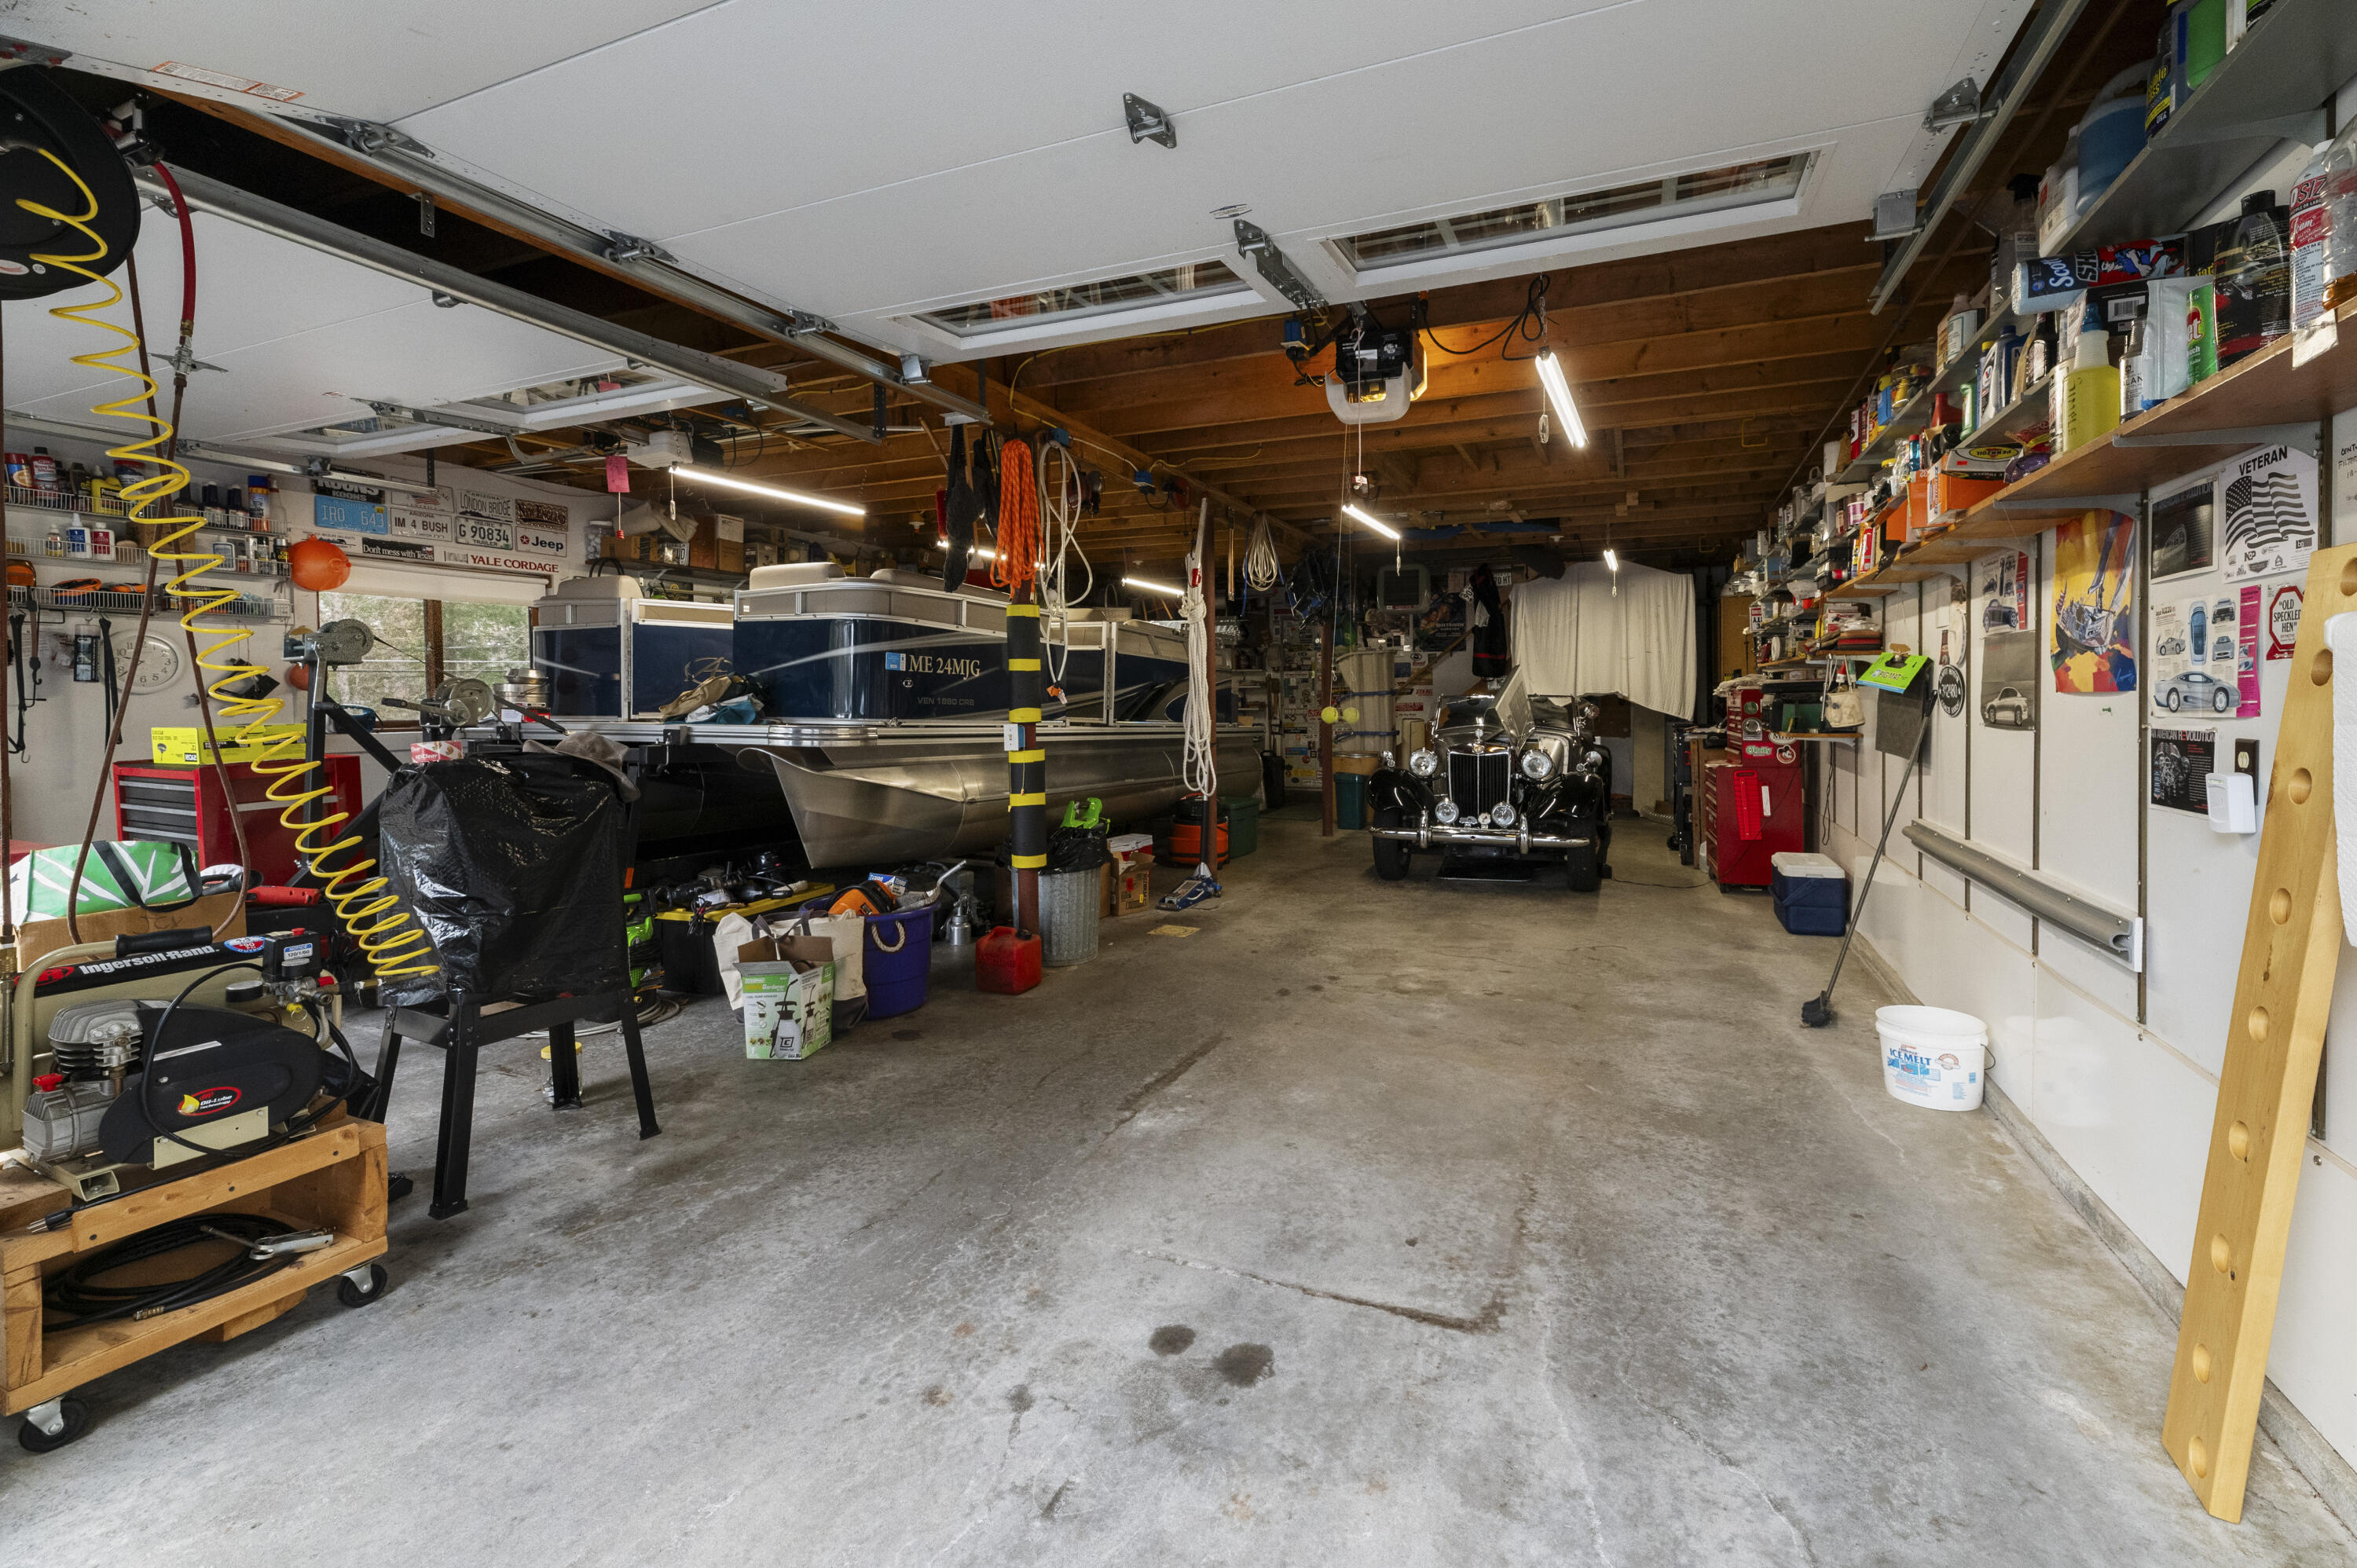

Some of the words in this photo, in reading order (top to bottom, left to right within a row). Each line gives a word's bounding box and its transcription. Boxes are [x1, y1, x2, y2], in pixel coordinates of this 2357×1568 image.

[2239, 445, 2288, 476] VETERAN
[332, 490, 367, 502] KOONS
[460, 492, 487, 512] LONDON
[488, 500, 511, 517] BRIDGE
[394, 516, 405, 528] IM
[411, 518, 416, 529] 4
[422, 520, 448, 533] BUSH
[458, 524, 467, 537] G
[471, 526, 510, 544] 90834
[531, 536, 564, 551] Jeep
[382, 547, 401, 557] mess
[401, 548, 416, 559] with
[416, 550, 434, 560] Texas
[471, 555, 502, 566] YALE
[504, 559, 559, 573] CORDAGE
[908, 654, 933, 673] ME
[936, 657, 981, 680] 24MJG
[2157, 729, 2178, 740] AMERICAN
[2178, 730, 2215, 742] REVOLUTION
[1890, 1047, 1902, 1060] ICE
[1904, 1053, 1931, 1067] MELT
